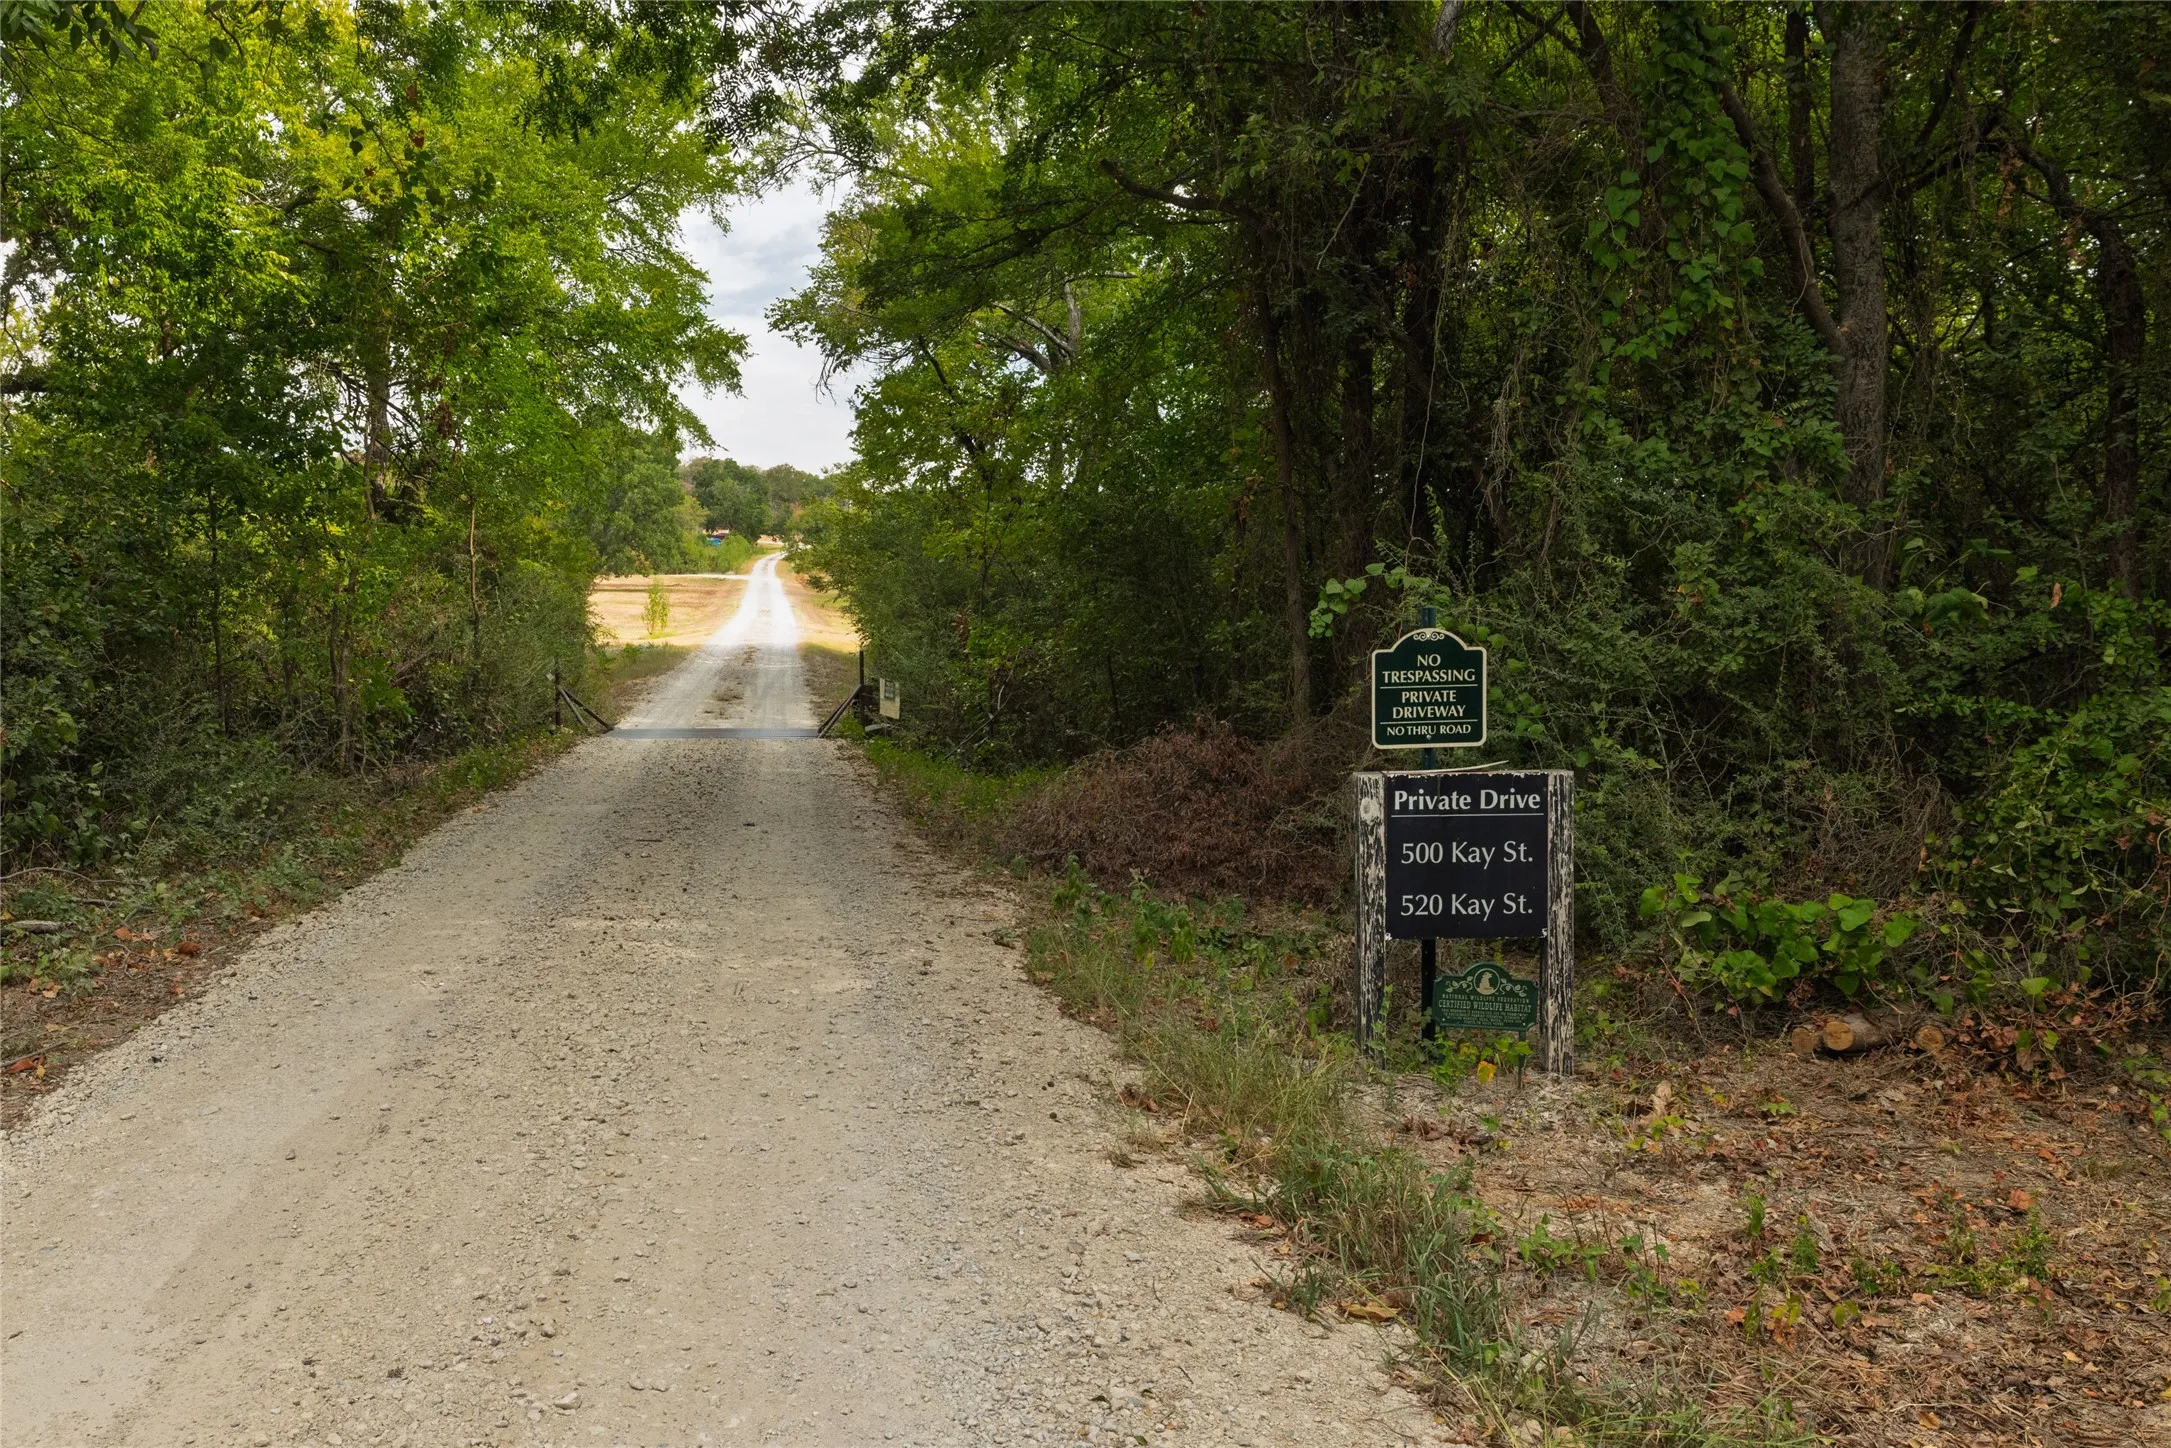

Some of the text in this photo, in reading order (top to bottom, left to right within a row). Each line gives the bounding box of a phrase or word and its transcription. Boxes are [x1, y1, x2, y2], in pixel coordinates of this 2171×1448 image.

[1417, 654, 1441, 667] NO
[1382, 669, 1475, 683] TRESPASSING
[1401, 690, 1457, 703] PRIVATE
[1392, 705, 1466, 719] DRIVEWAY
[1387, 724, 1471, 736] NO THRU ROAD
[1394, 787, 1540, 810] Private Drive
[1401, 840, 1533, 869] 500 Kay St.
[1400, 892, 1533, 922] 520 Kay St.
[1438, 1000, 1471, 1009] CERTIFIED
[1473, 1001, 1502, 1011] WILDLIFE
[1505, 1003, 1532, 1012] HABITAT
